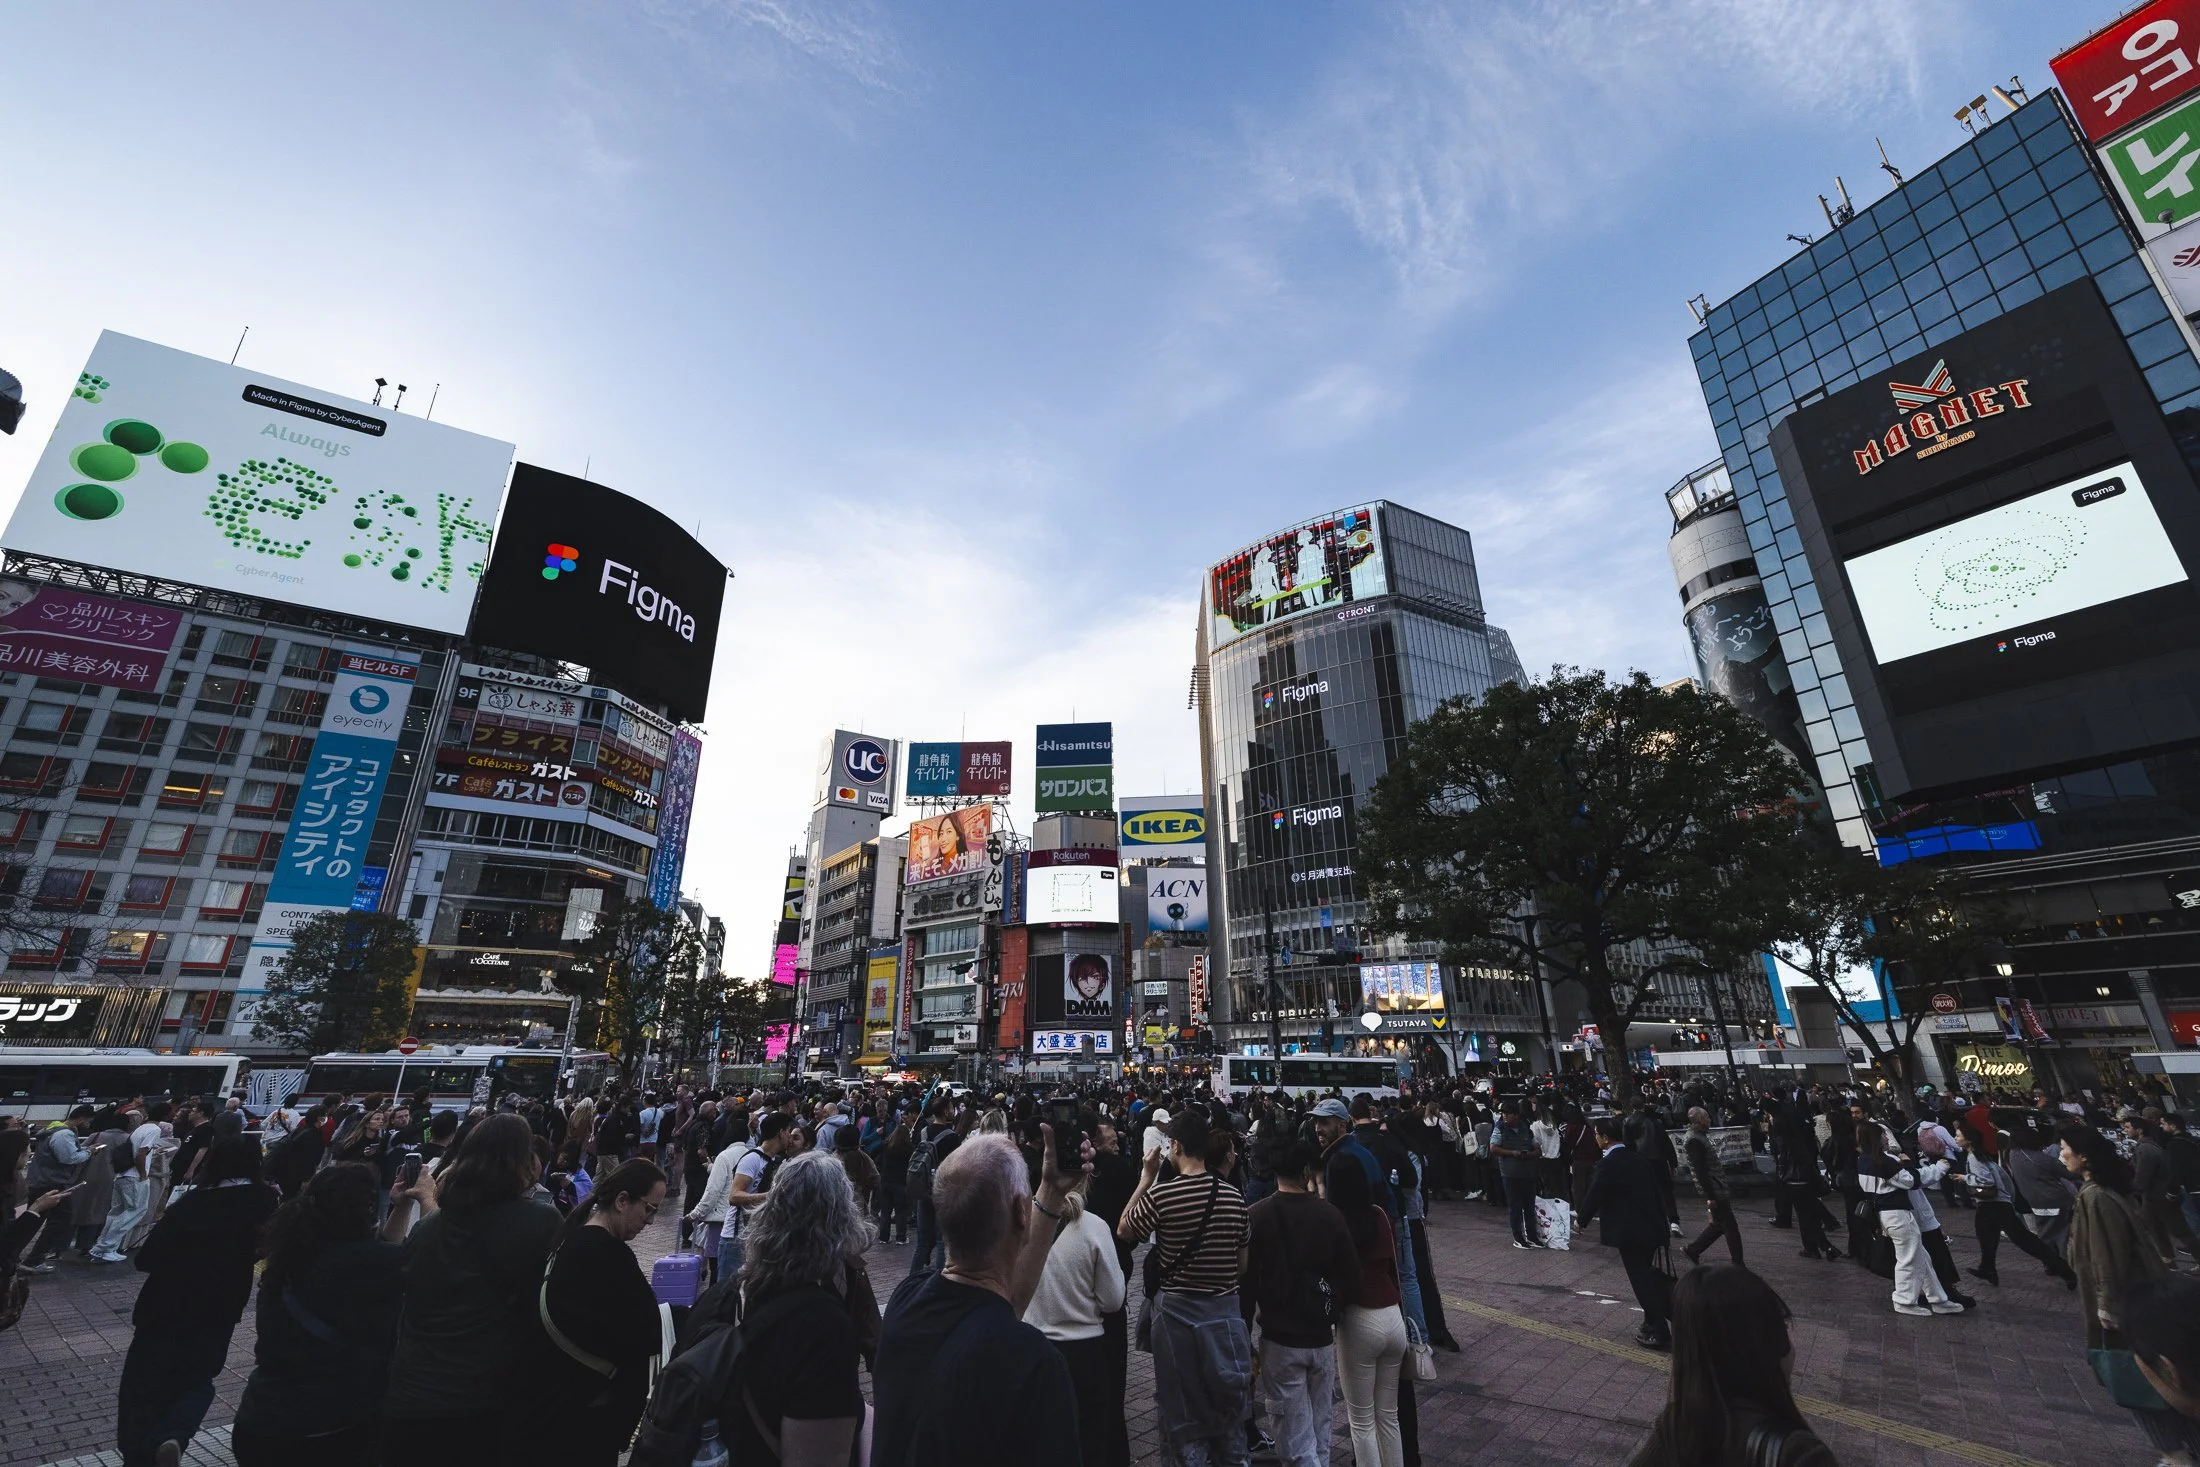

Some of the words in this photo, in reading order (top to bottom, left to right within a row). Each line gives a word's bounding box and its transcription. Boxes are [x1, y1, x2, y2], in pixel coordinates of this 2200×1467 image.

[251, 390, 278, 404] Made
[278, 398, 288, 407] in
[289, 401, 316, 416] Figma
[317, 407, 328, 418] by
[328, 411, 382, 433] CyberAgent
[1853, 379, 2032, 475] MAGNET
[260, 423, 351, 458] Always
[1935, 433, 1948, 442] by
[2081, 483, 2116, 501] Figma
[235, 564, 305, 586] CyberAgent
[599, 559, 695, 643] Figma
[71, 602, 171, 628] 品川スキン
[1337, 605, 1376, 621] QFRONT
[66, 617, 156, 641] クリニック
[2013, 630, 2056, 649] Figma
[0, 644, 150, 683] 品川美容外科
[349, 657, 411, 676] 当ビル5F
[458, 688, 479, 699] 9F
[1282, 680, 1329, 703] Figma
[517, 693, 576, 716] しゃぶ葉
[333, 714, 393, 733] eyecity
[475, 727, 569, 753] プライス
[1037, 740, 1111, 751] Hisamitsu
[598, 746, 650, 779] コンタクト
[919, 753, 950, 767] 龍角散
[971, 752, 1002, 766] 龍角散
[435, 772, 459, 787] 7F
[530, 762, 578, 781] ガスト
[492, 778, 554, 802] ガスト
[1040, 778, 1109, 798] サロンパス
[633, 789, 658, 808] ガスト
[869, 795, 888, 805] VISA
[291, 754, 353, 876] アイシティ
[326, 758, 380, 877] コンタクトの
[1292, 805, 1342, 826] Figma
[1131, 819, 1202, 834] IKEA
[1053, 851, 1090, 861] Rakuten
[984, 833, 1004, 910] もんじゃ
[1150, 879, 1206, 898] ACN
[1387, 1020, 1427, 1028] TSUTAYA
[1960, 1055, 2028, 1076] Dimoo
